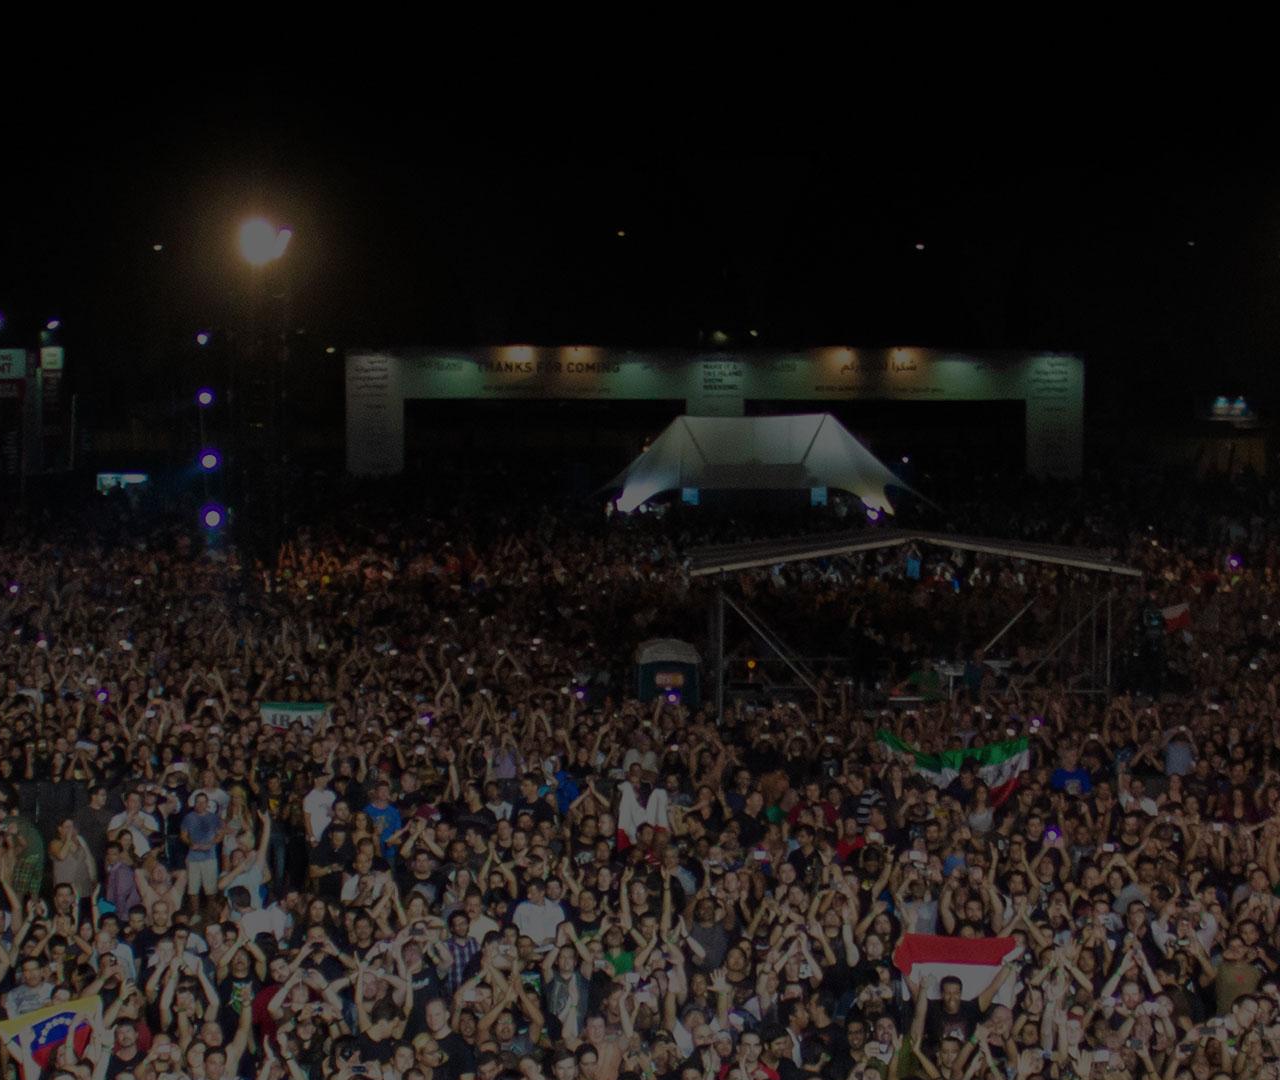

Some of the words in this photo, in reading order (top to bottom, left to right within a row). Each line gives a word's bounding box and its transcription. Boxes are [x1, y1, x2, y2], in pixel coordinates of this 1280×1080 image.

[477, 361, 532, 373] THANKS
[536, 361, 563, 373] FOR
[566, 361, 620, 374] COMING
